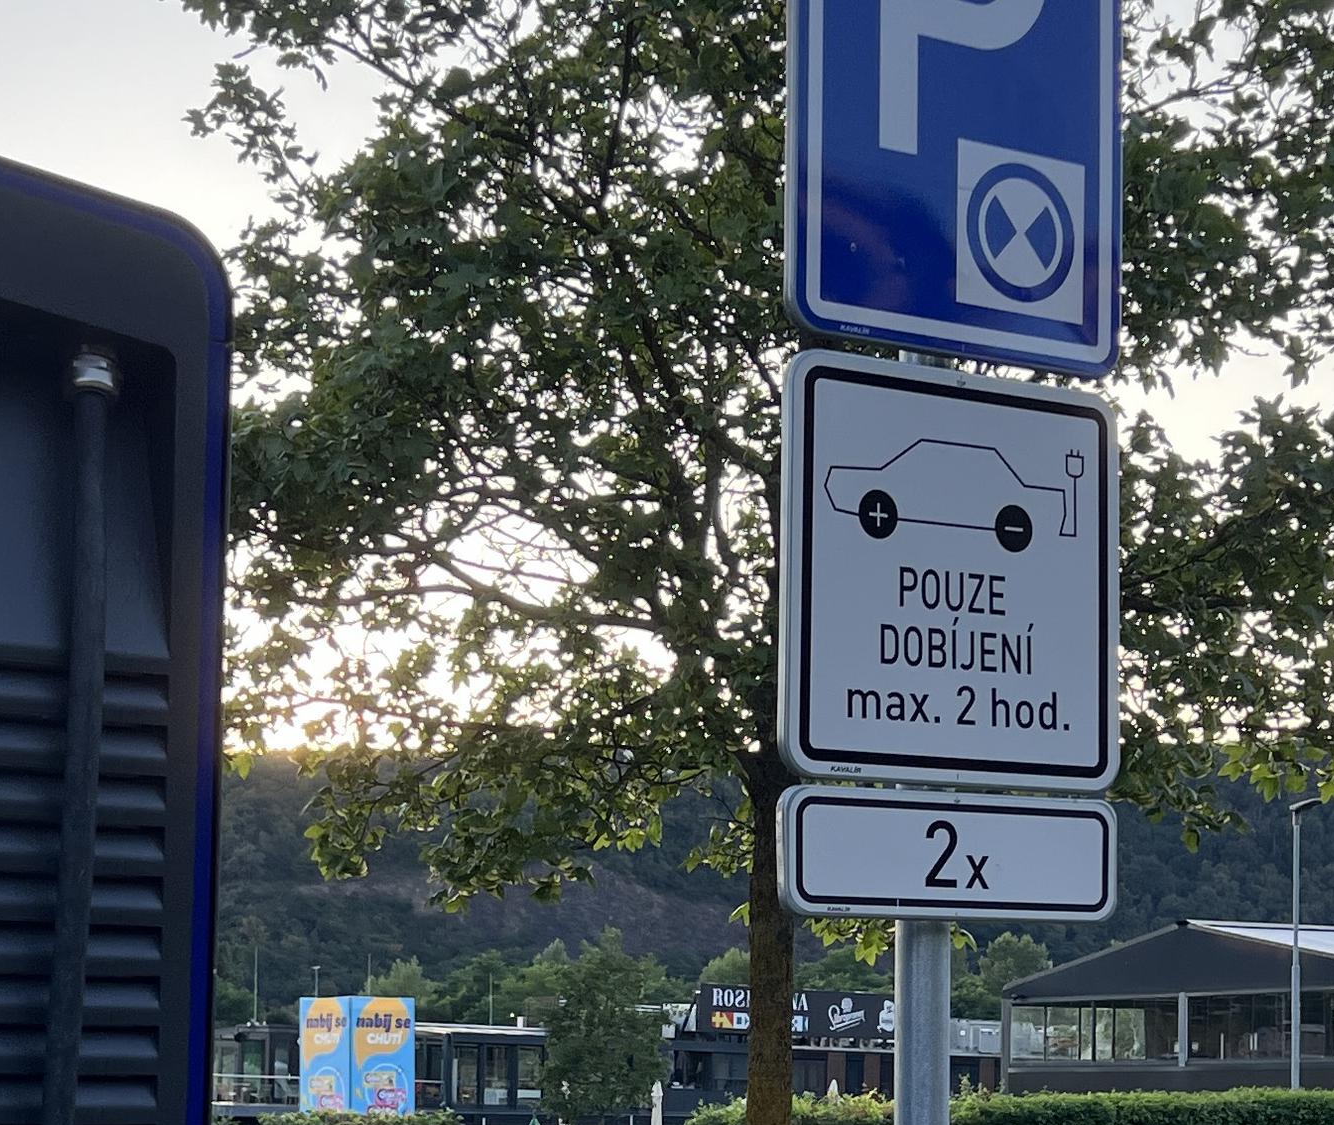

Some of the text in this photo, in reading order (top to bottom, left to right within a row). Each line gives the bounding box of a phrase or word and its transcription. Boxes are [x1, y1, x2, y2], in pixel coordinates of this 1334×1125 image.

[879, 0, 1045, 155] P
[899, 566, 1006, 616] POUZE
[880, 617, 1034, 675] DOBÍJENÍ
[847, 685, 1070, 731] max. 2 hod.
[925, 819, 990, 890] 2x
